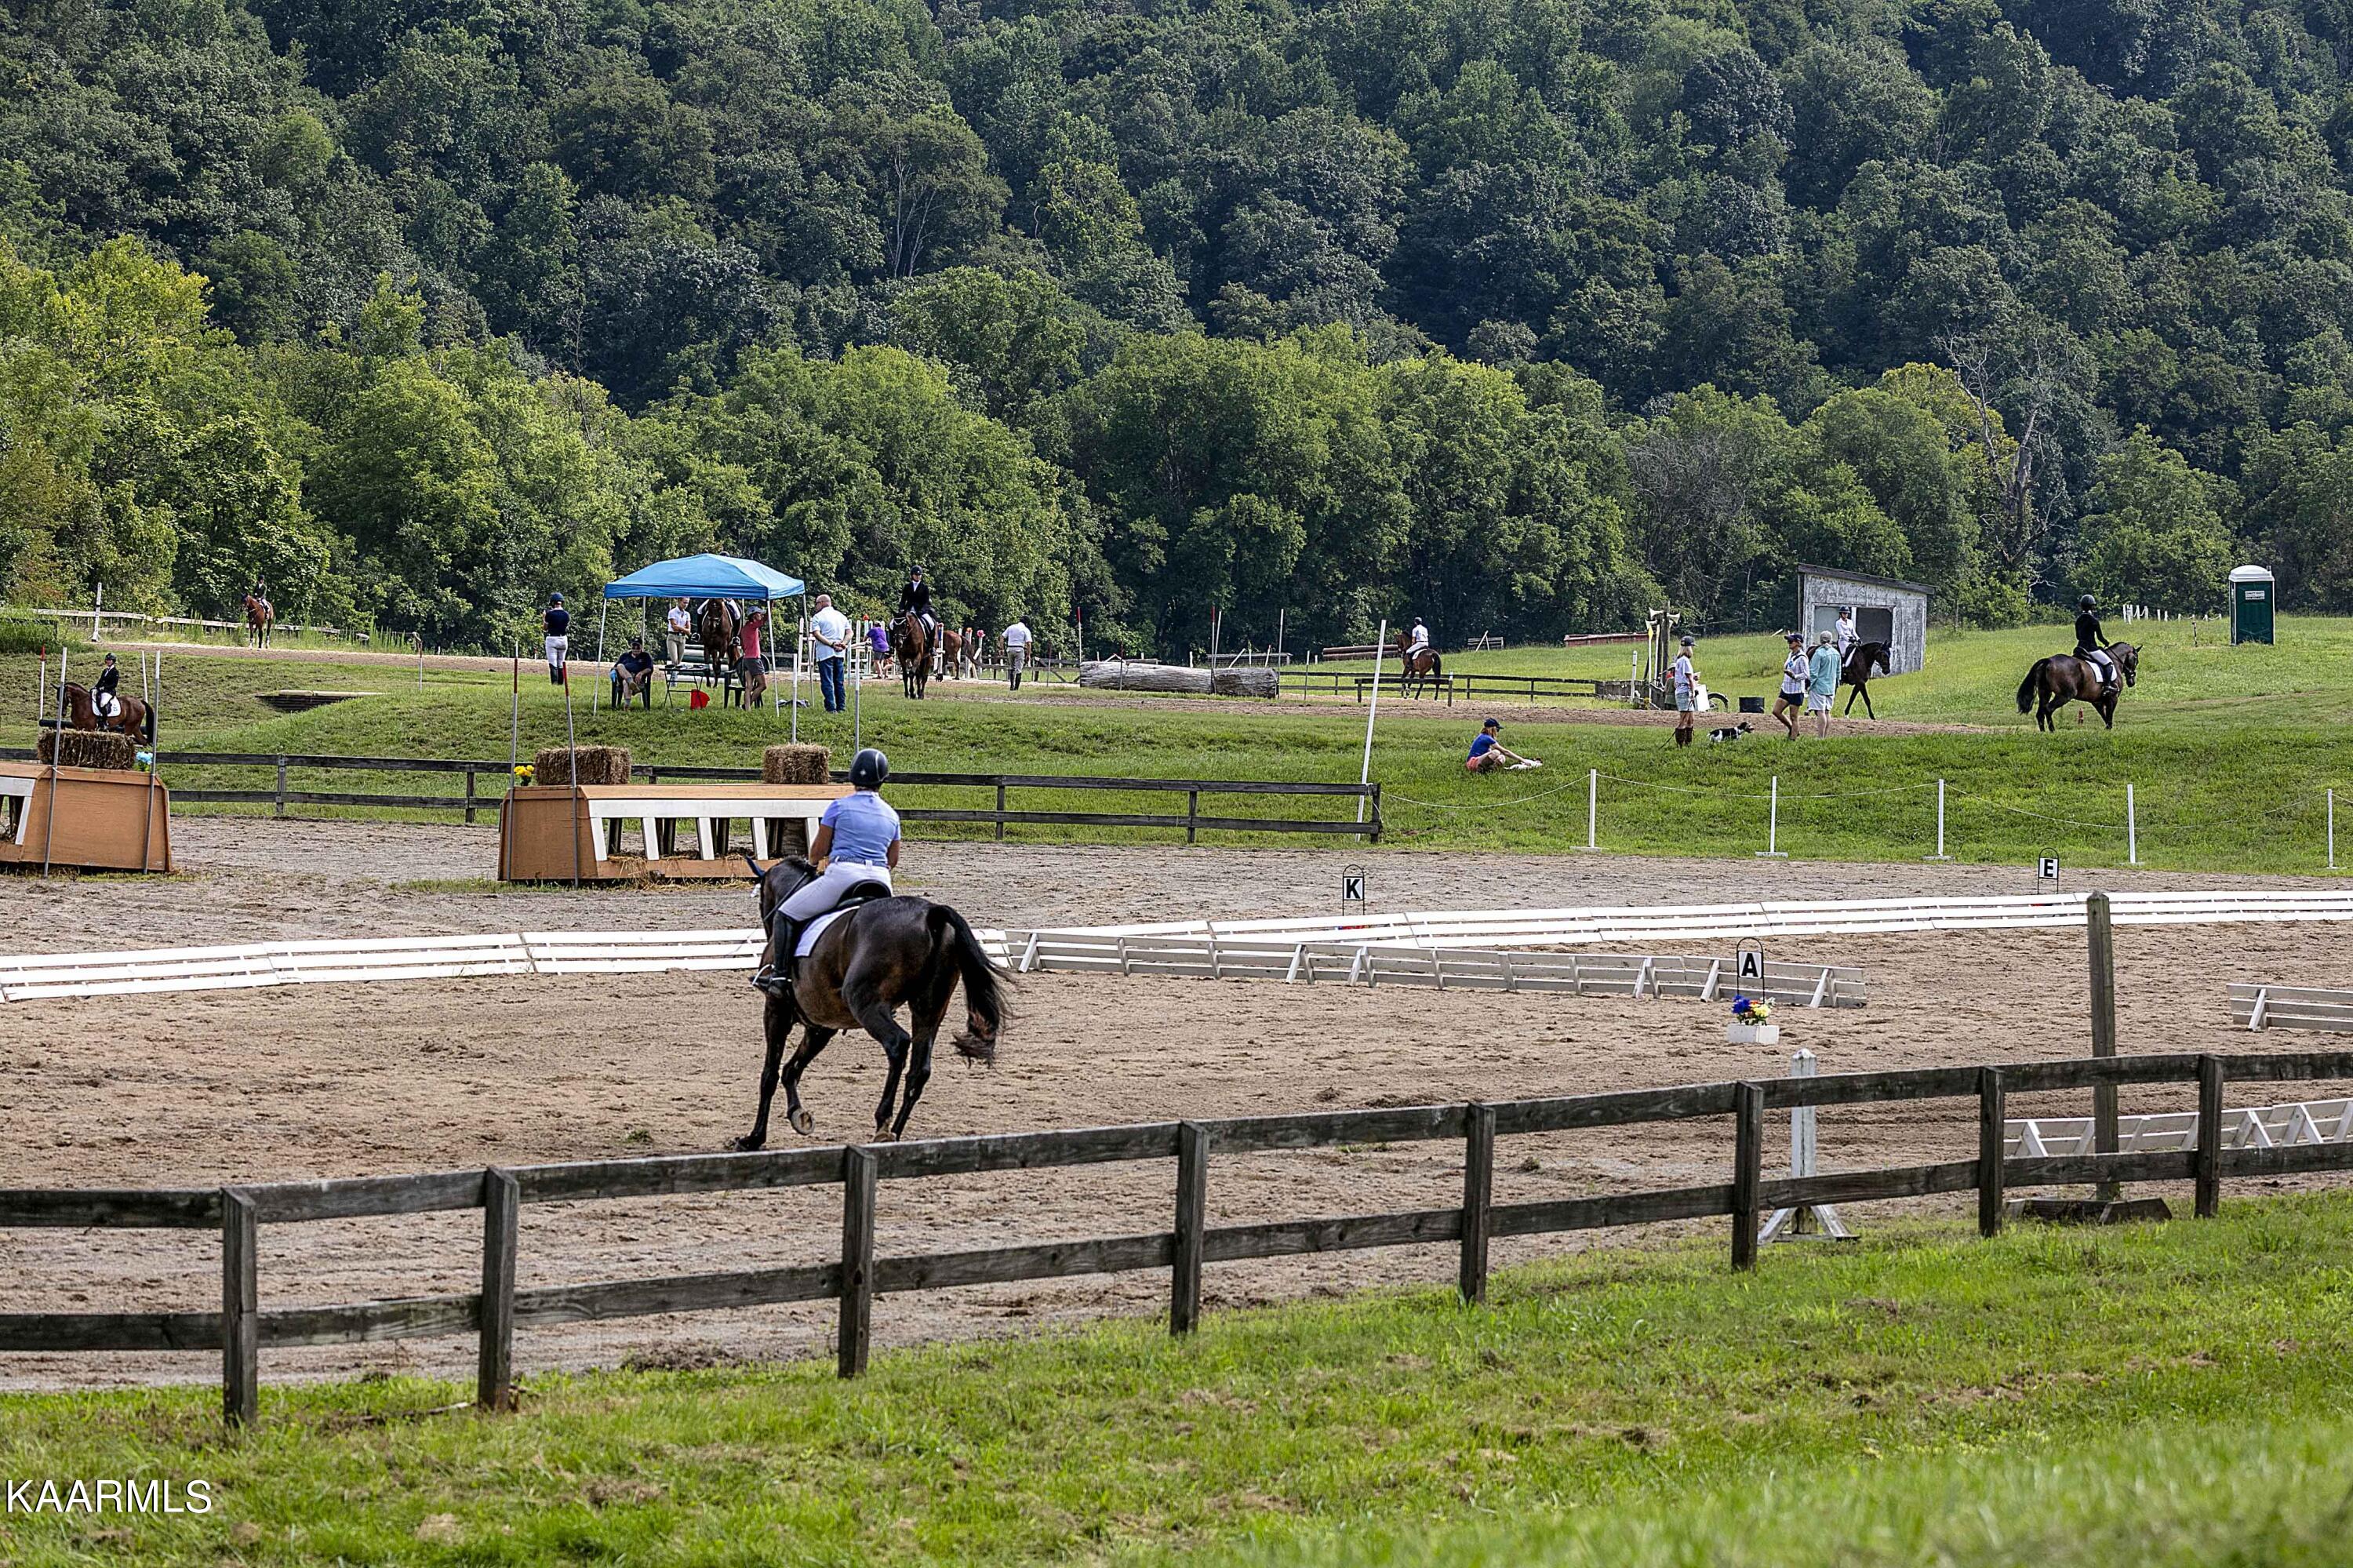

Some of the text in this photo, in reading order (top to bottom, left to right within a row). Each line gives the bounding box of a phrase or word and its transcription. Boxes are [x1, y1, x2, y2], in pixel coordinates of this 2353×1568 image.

[2044, 859, 2053, 877] E
[1346, 879, 1361, 899] K
[1741, 952, 1758, 977] A
